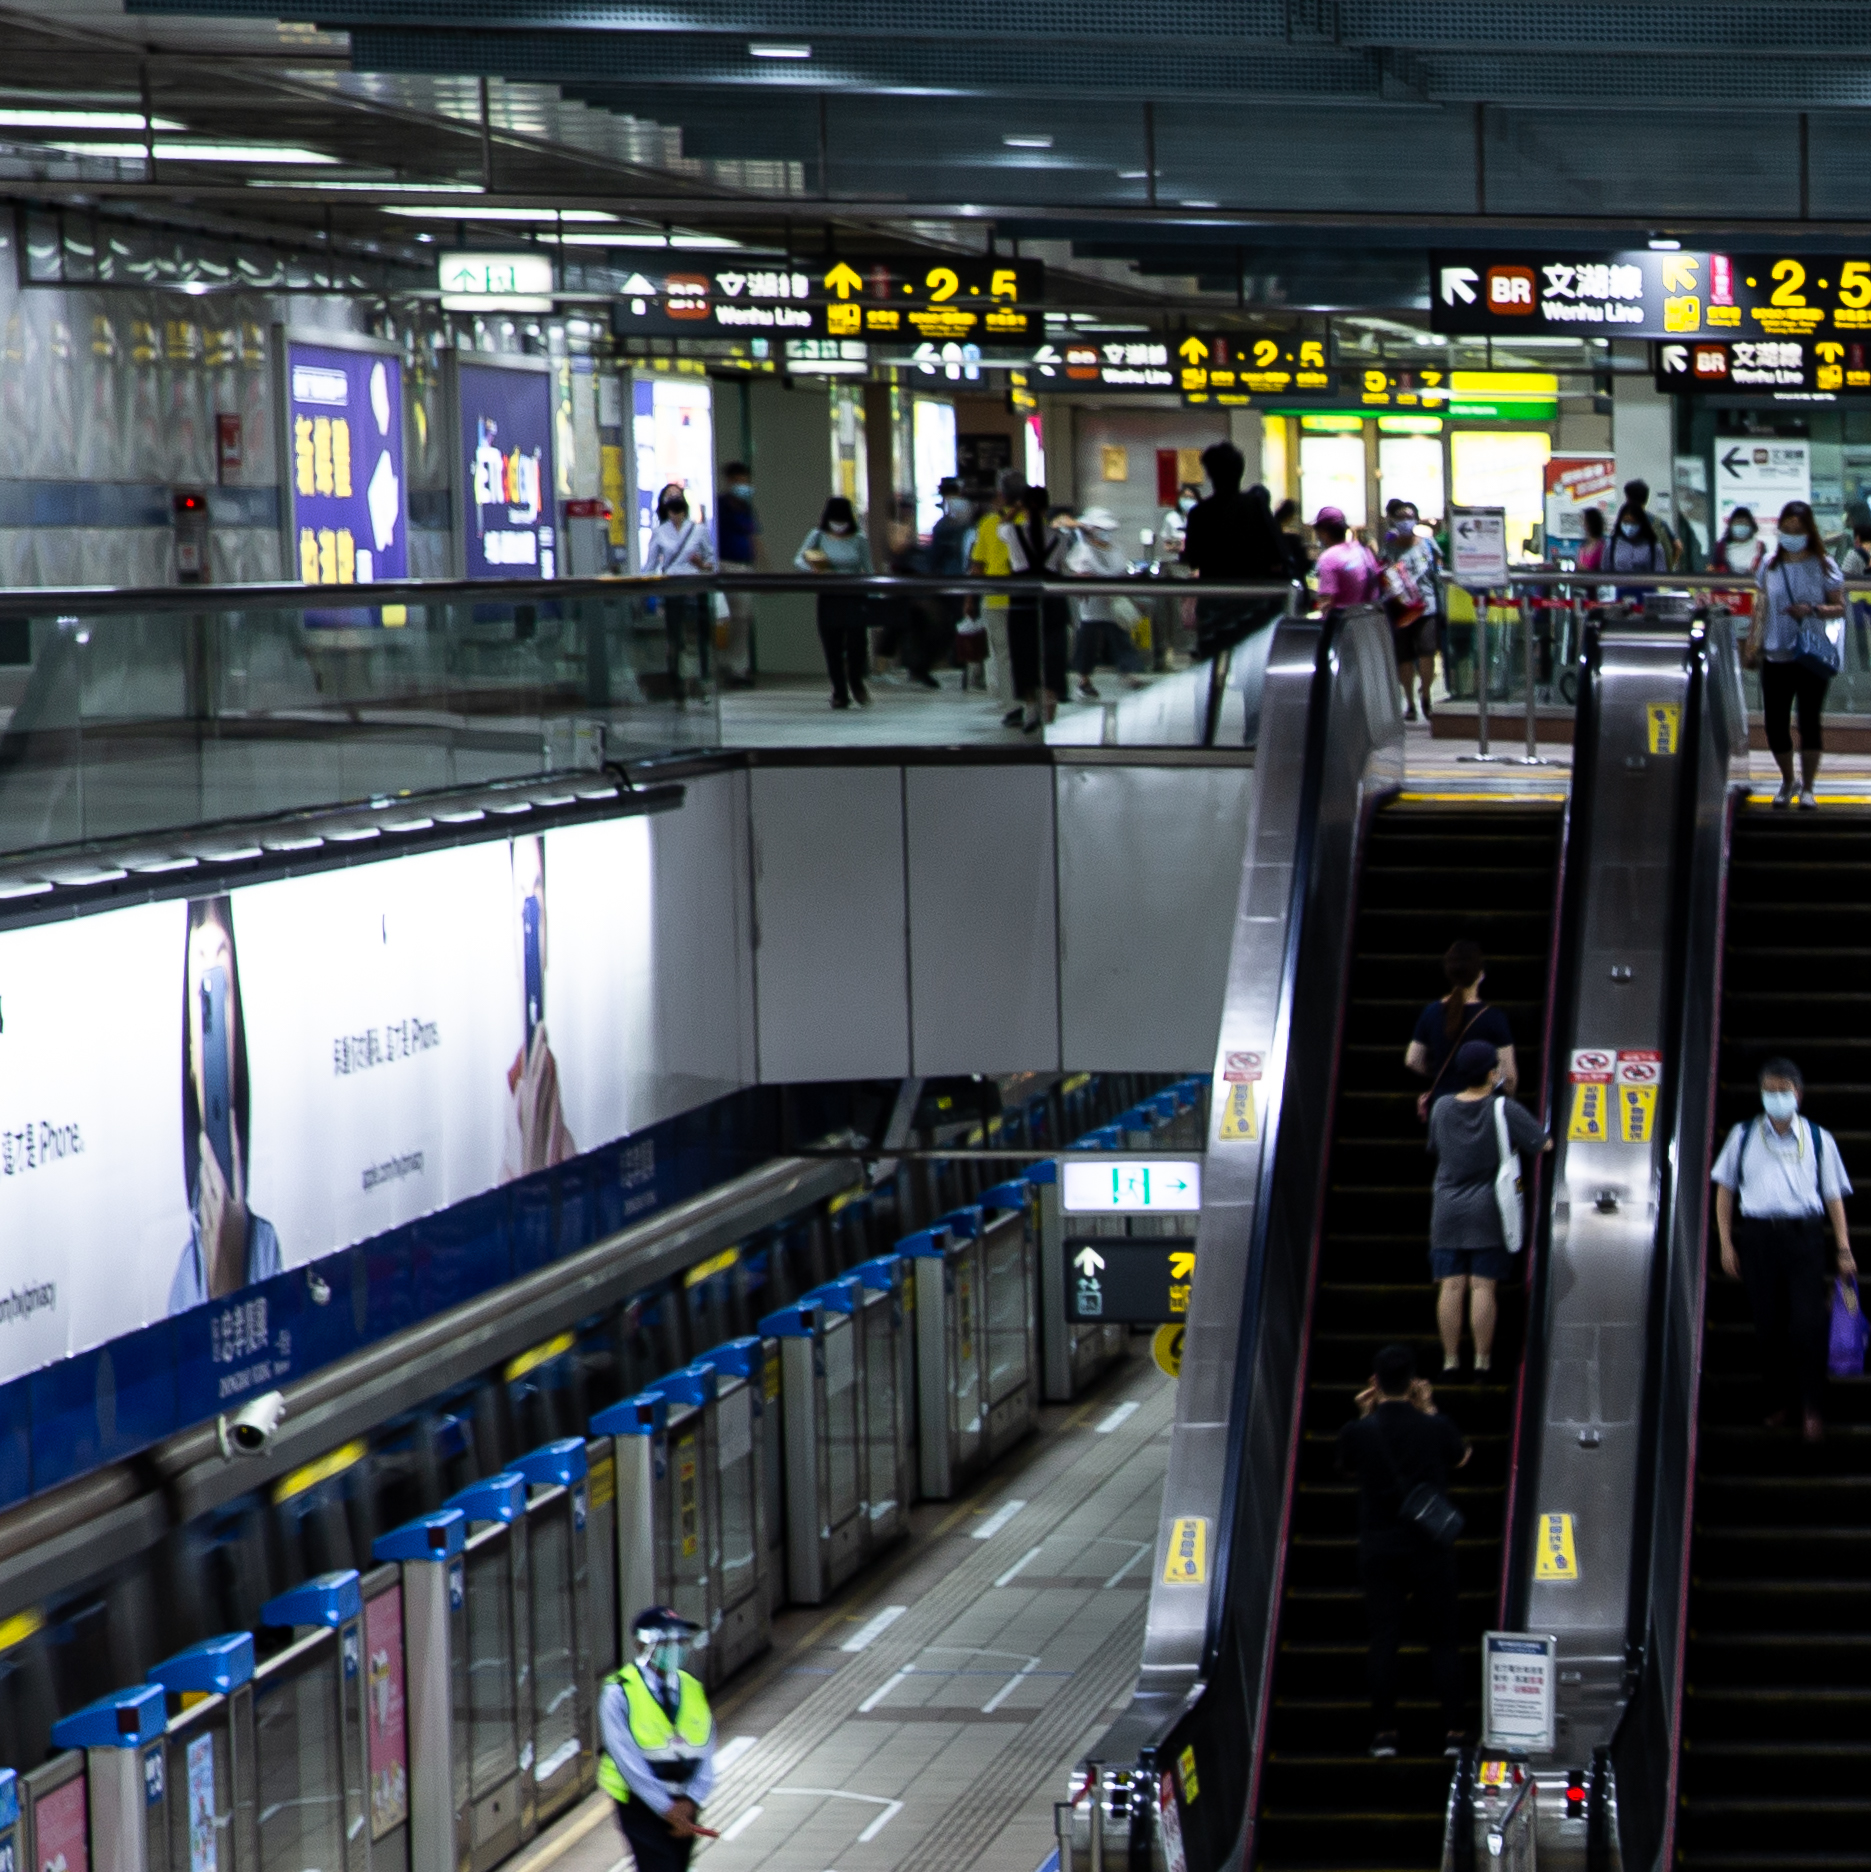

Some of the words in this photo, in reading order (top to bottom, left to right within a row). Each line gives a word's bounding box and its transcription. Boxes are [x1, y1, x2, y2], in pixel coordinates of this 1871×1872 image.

[1491, 276, 1532, 304] BR
[1541, 262, 1644, 300] 文湖線
[1770, 259, 1806, 307] 2
[1541, 301, 1603, 324] Wenhu
[1605, 302, 1645, 325] Line
